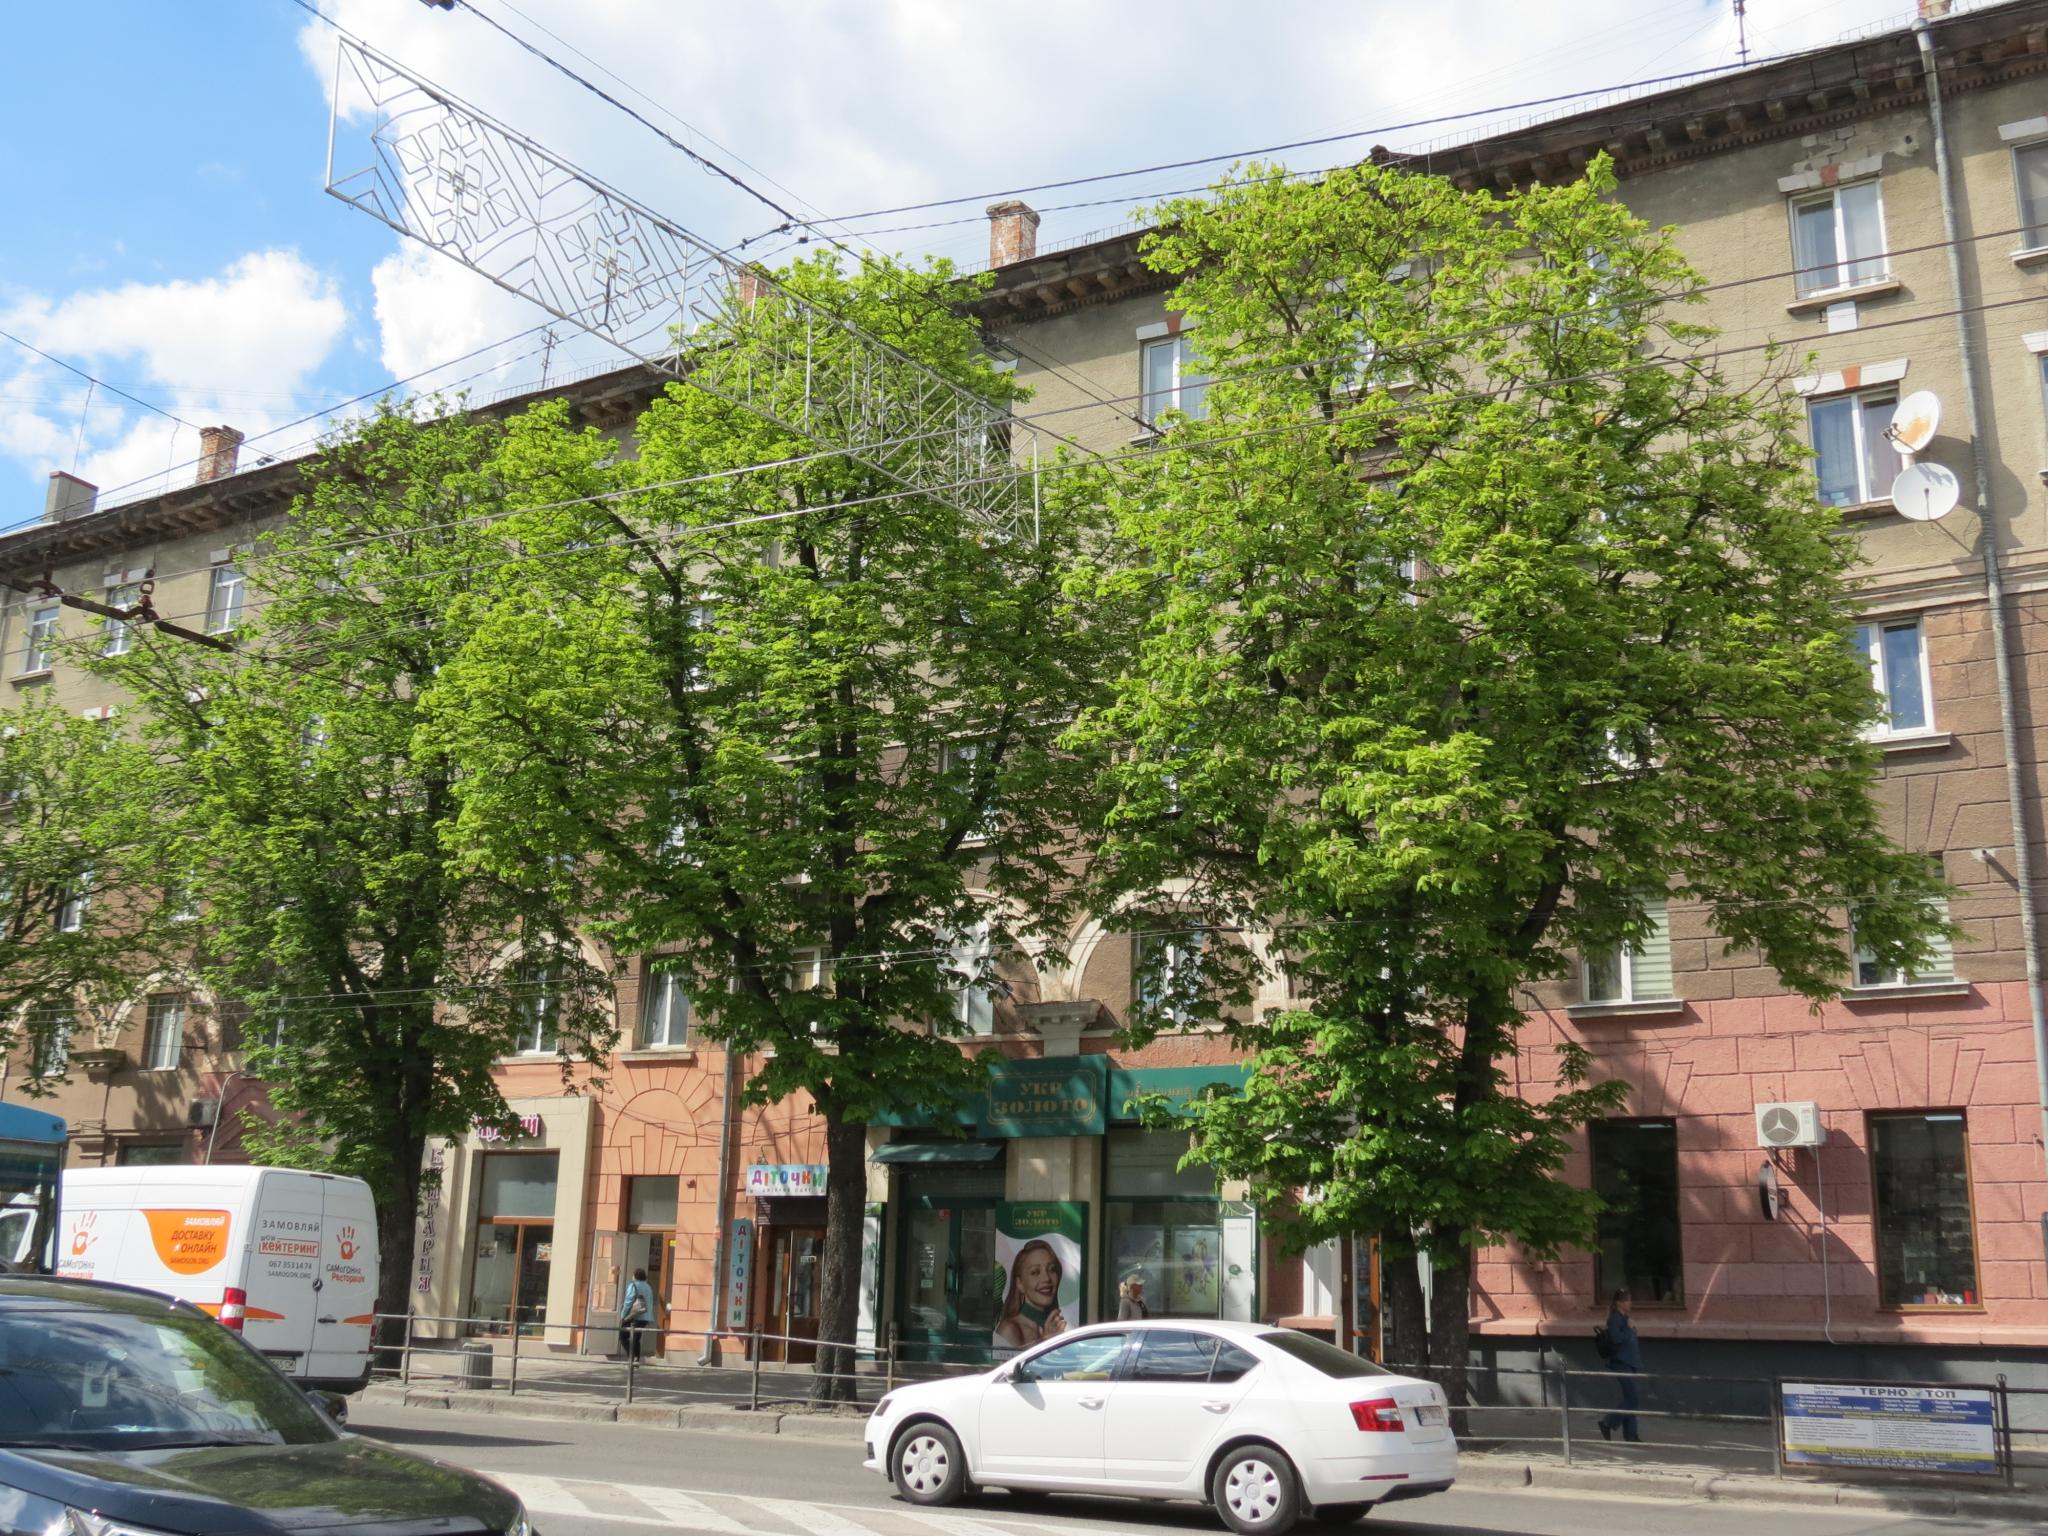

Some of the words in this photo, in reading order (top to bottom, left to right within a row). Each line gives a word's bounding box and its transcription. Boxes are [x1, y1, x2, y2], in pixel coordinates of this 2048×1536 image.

[1020, 1082, 1062, 1096] УКР
[994, 1099, 1089, 1115] ЗОЛОТО
[751, 1169, 825, 1188] ДІТОЧКИ
[261, 1219, 320, 1233] ЗАМОВЛЯЙ
[417, 1149, 443, 1292] КИГАРНЯ
[170, 1230, 216, 1241] ДОСТАВКУ
[180, 1241, 217, 1254] ОНЛАЙН
[733, 1224, 747, 1322] ДІТОЧКИ
[1859, 1387, 1908, 1397] ТЕРНО
